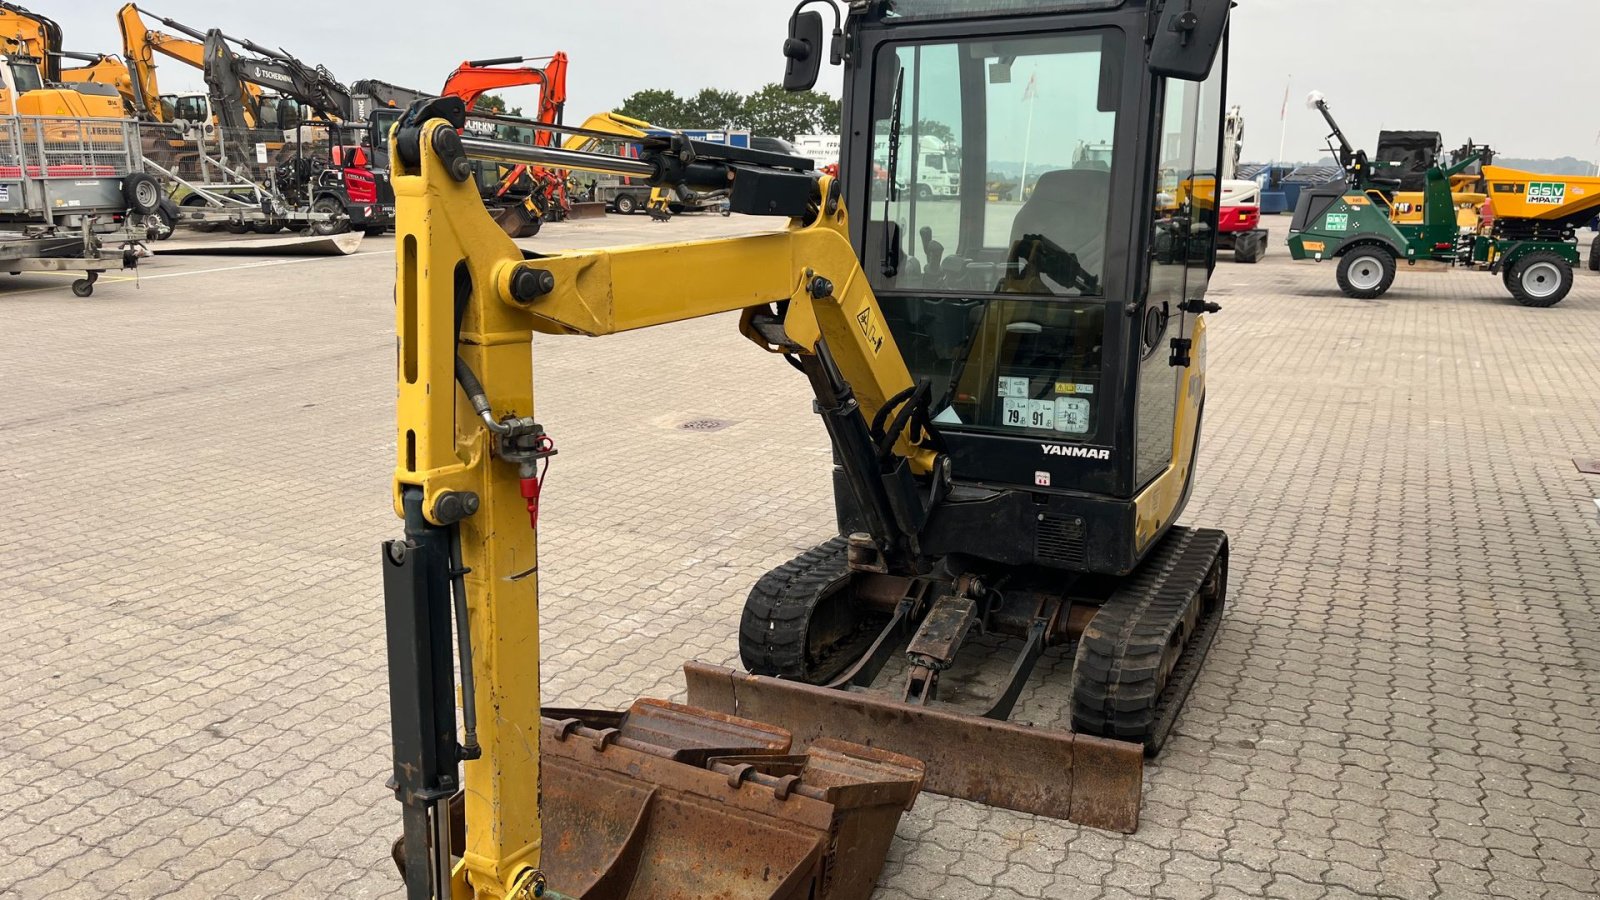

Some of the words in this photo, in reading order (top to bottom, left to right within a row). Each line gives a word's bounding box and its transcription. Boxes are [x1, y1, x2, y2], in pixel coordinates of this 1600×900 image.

[1529, 187, 1563, 196] GSV
[1393, 203, 1410, 213] CAT
[1008, 409, 1020, 424] 79
[1032, 411, 1044, 426] 91
[1041, 444, 1110, 460] YANMAR
